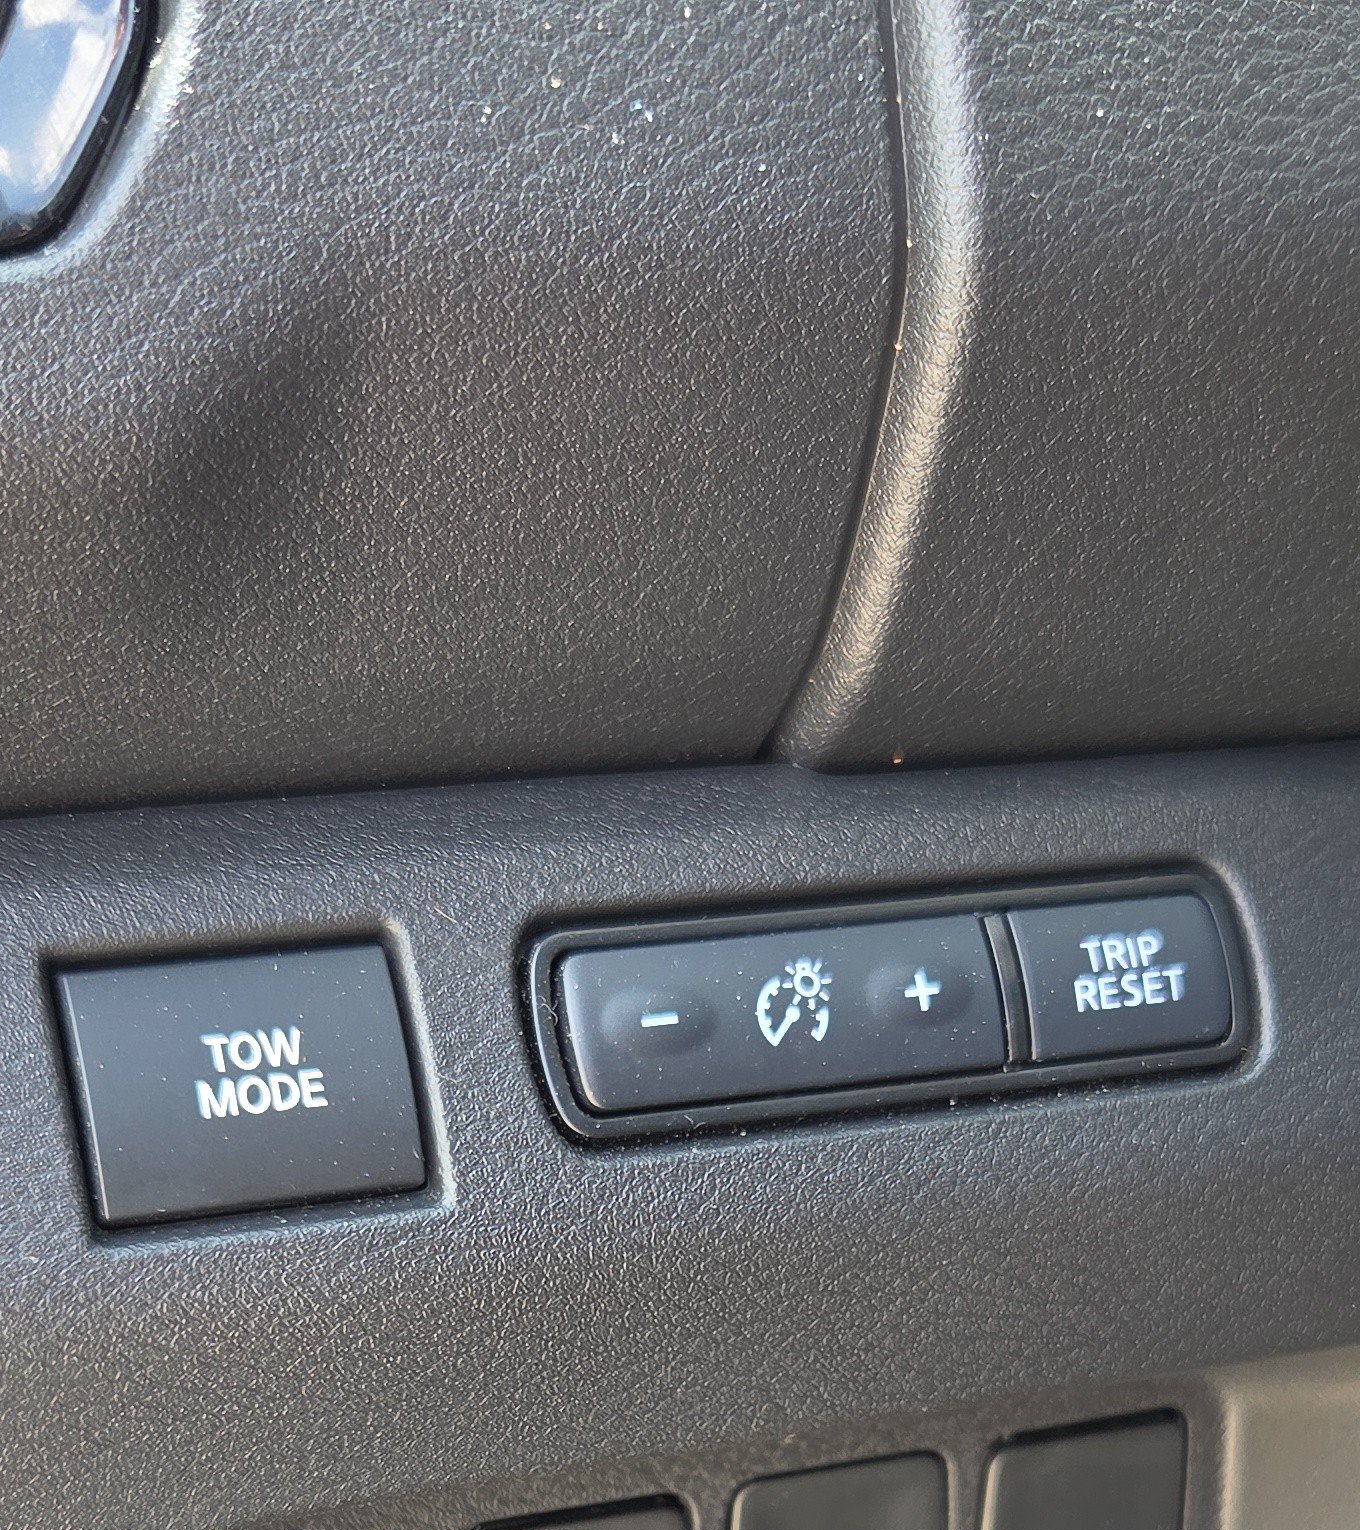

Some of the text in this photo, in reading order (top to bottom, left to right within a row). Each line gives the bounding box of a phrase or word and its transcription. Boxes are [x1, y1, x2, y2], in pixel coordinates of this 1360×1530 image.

[1079, 929, 1164, 973] TRIP
[1073, 962, 1187, 1013] RESET
[199, 1025, 301, 1073] TOW
[193, 1066, 329, 1120] MODE
